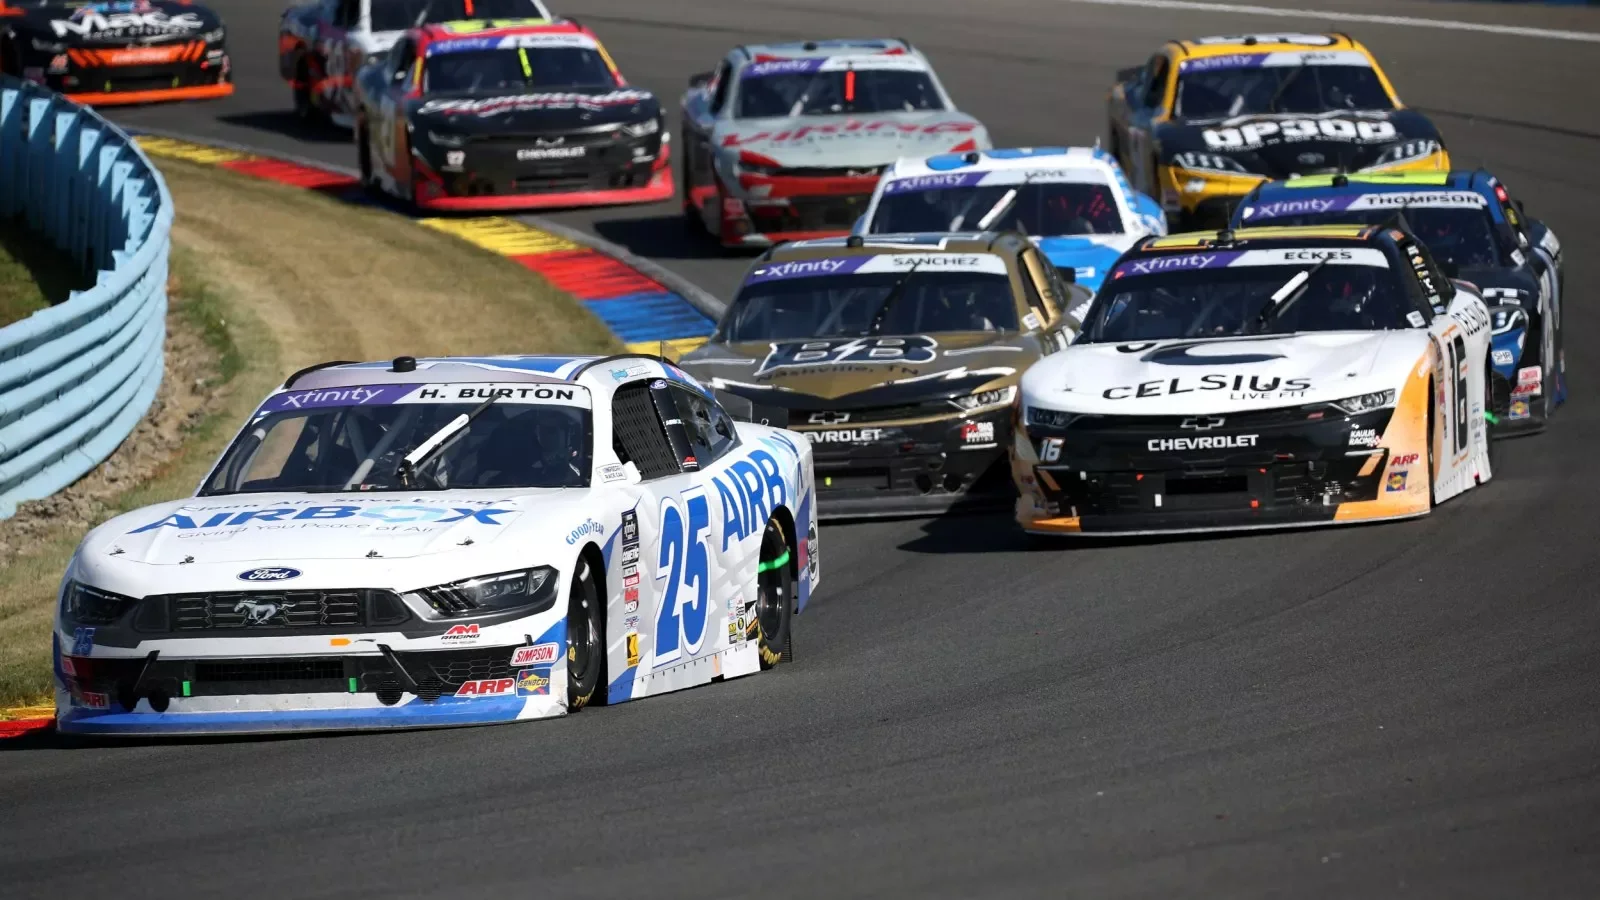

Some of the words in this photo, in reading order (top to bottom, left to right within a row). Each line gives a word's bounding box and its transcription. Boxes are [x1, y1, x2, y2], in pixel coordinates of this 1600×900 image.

[753, 60, 811, 75] xfinity
[1190, 55, 1252, 68] xfinity
[516, 146, 586, 161] CHEVROLET
[900, 173, 967, 190] xfinity
[1259, 198, 1335, 217] xfinity
[1366, 193, 1479, 205] THOMPSON
[768, 259, 846, 276] xfinity
[893, 257, 979, 266] SANCHEZ
[1132, 254, 1216, 273] xfinity
[1284, 251, 1353, 260] ECKES
[884, 364, 919, 376] TN
[1102, 374, 1312, 400] CELSIUS
[1230, 392, 1271, 400] LIVE
[1279, 390, 1306, 398] FIT
[282, 387, 385, 408] xfinity
[420, 388, 447, 400] H.
[458, 388, 574, 400] BURTON
[803, 428, 883, 443] EVROLET
[1147, 434, 1260, 451] CHEVROLET
[1040, 438, 1064, 462] 16
[1390, 453, 1419, 466] ARP
[125, 505, 517, 535] AIRBOX
[177, 526, 249, 539] Giving
[256, 523, 296, 531] You
[300, 522, 370, 530] Peace
[375, 524, 401, 532] of
[565, 517, 605, 545] GOODYEAR
[248, 568, 291, 581] Ford
[655, 493, 711, 659] 25
[445, 624, 479, 634] AM
[515, 647, 553, 663] SIMPSON
[457, 679, 514, 695] ARP
[518, 678, 549, 687] SUNOCO
